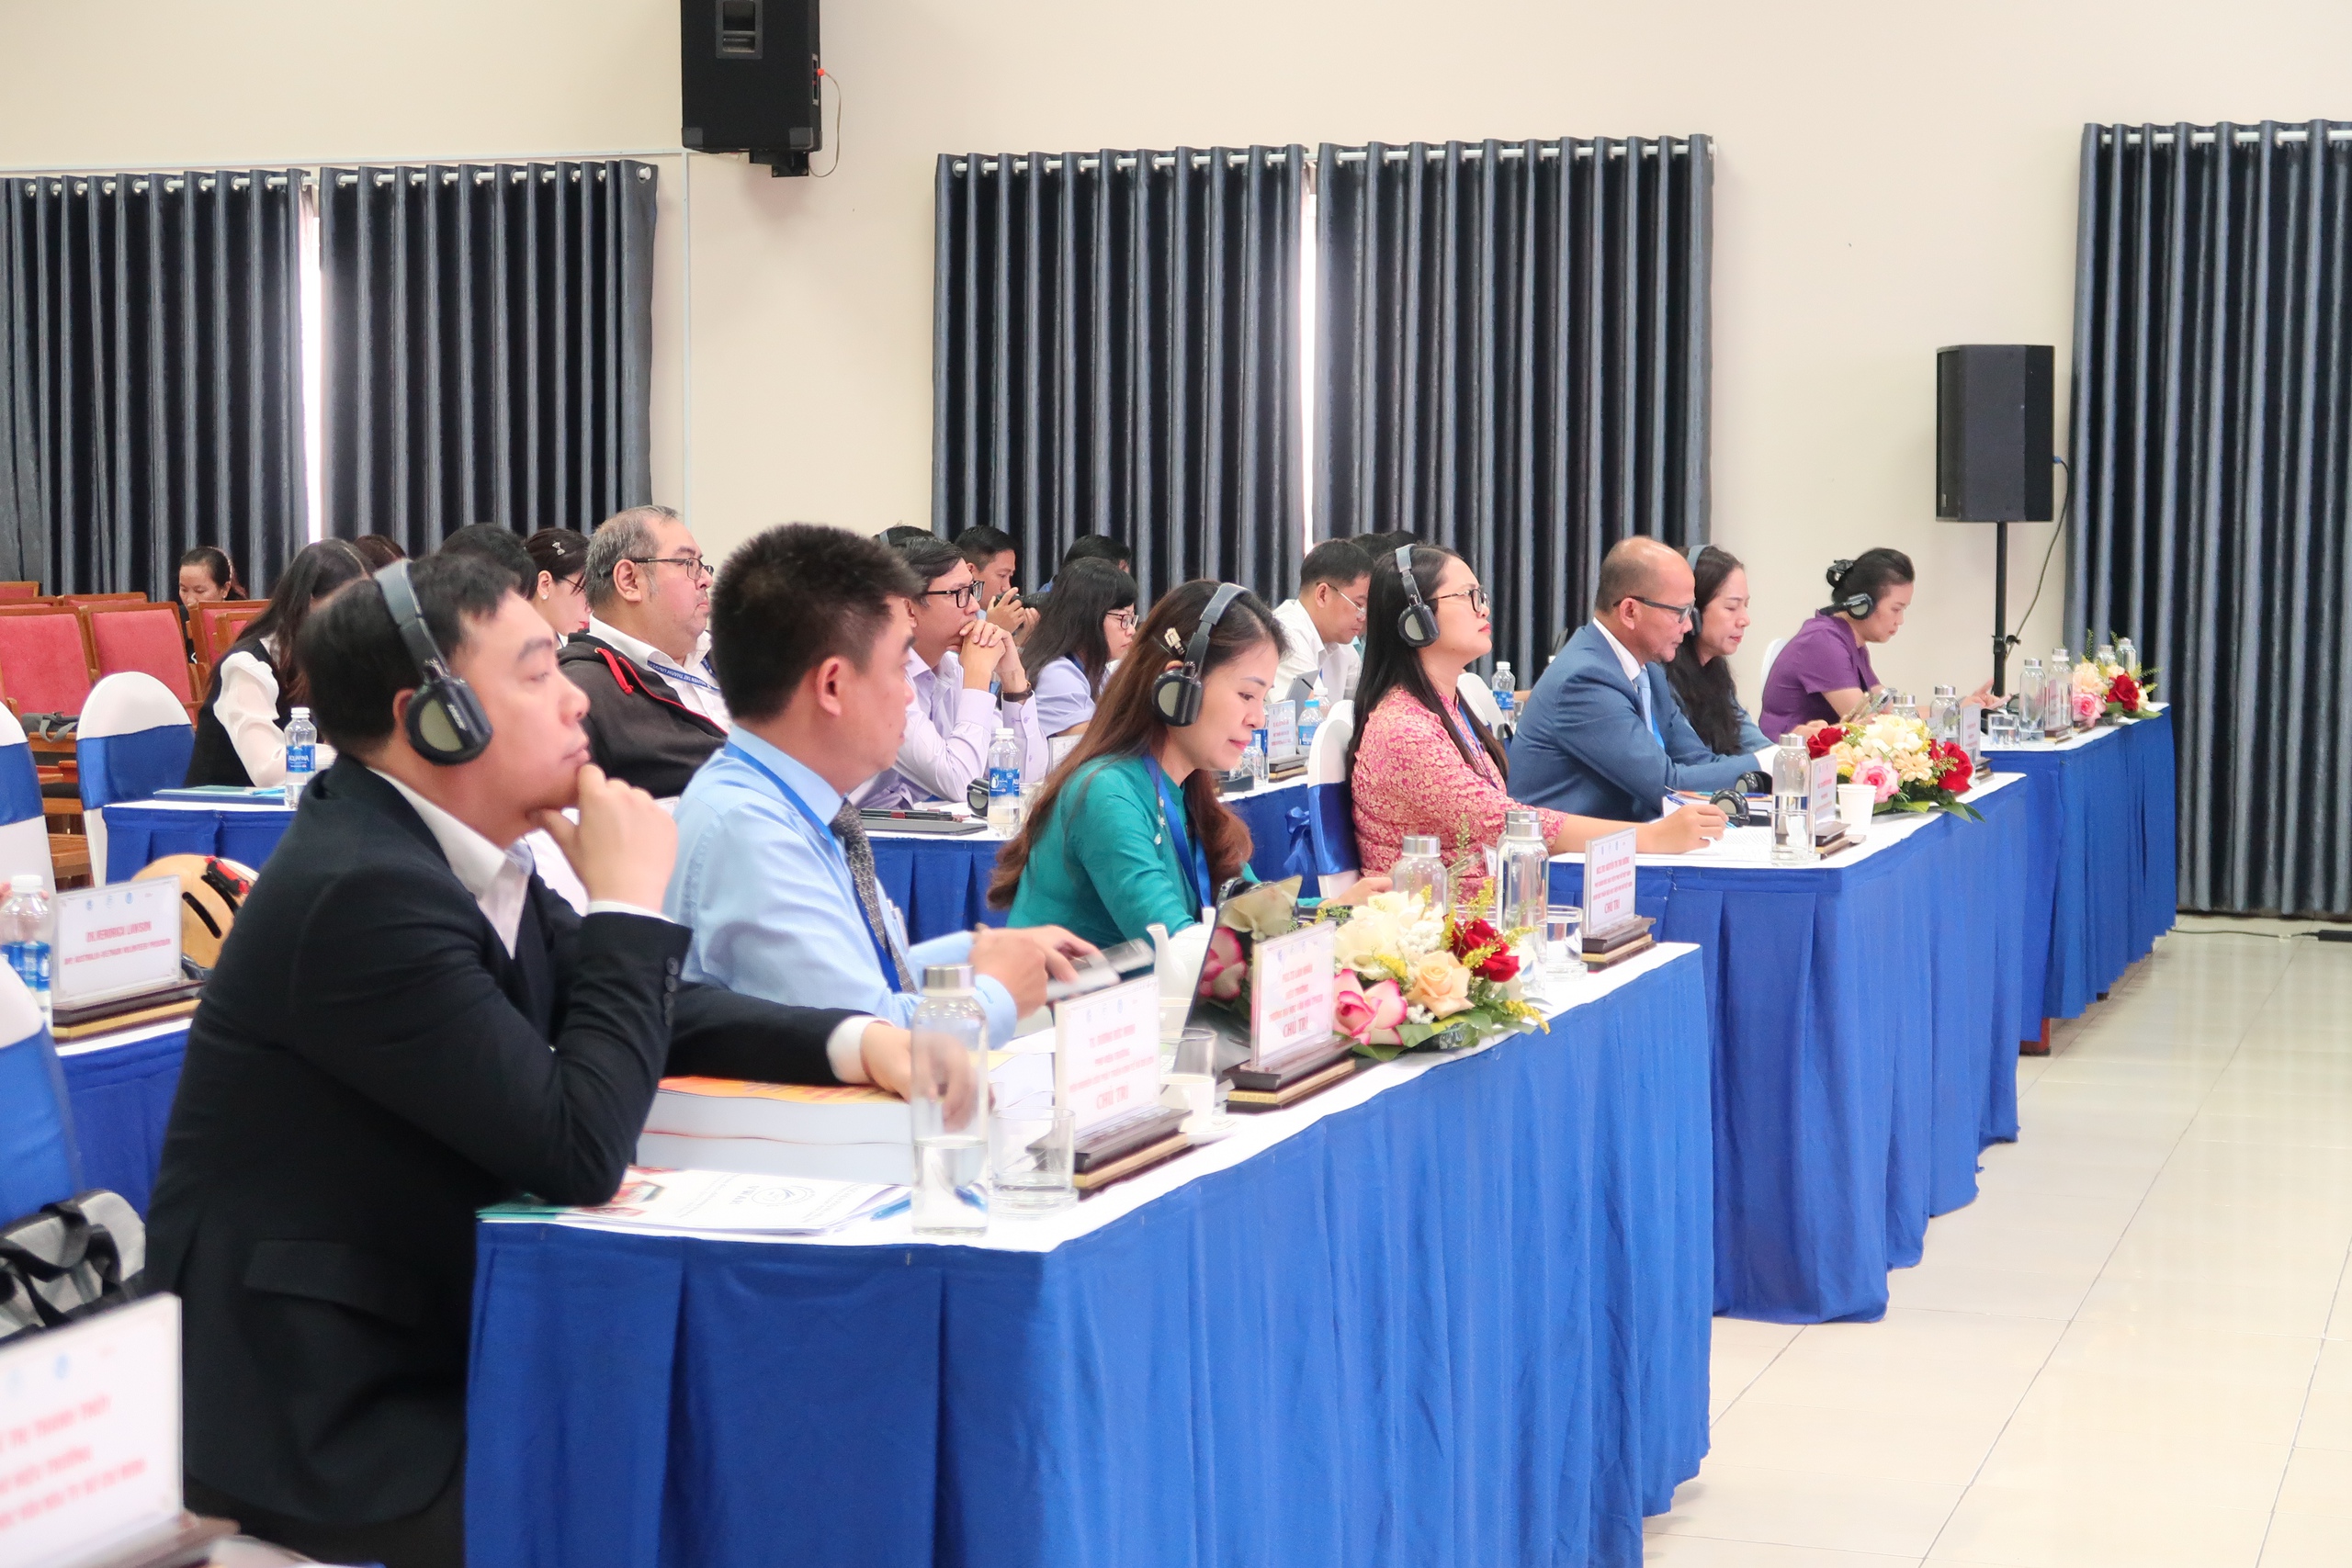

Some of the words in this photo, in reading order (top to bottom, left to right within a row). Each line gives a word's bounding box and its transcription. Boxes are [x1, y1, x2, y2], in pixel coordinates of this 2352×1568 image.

[1283, 1019, 1296, 1038] CHỦ
[1298, 1014, 1308, 1032] TRÌ
[1097, 1088, 1114, 1111] CHỦ
